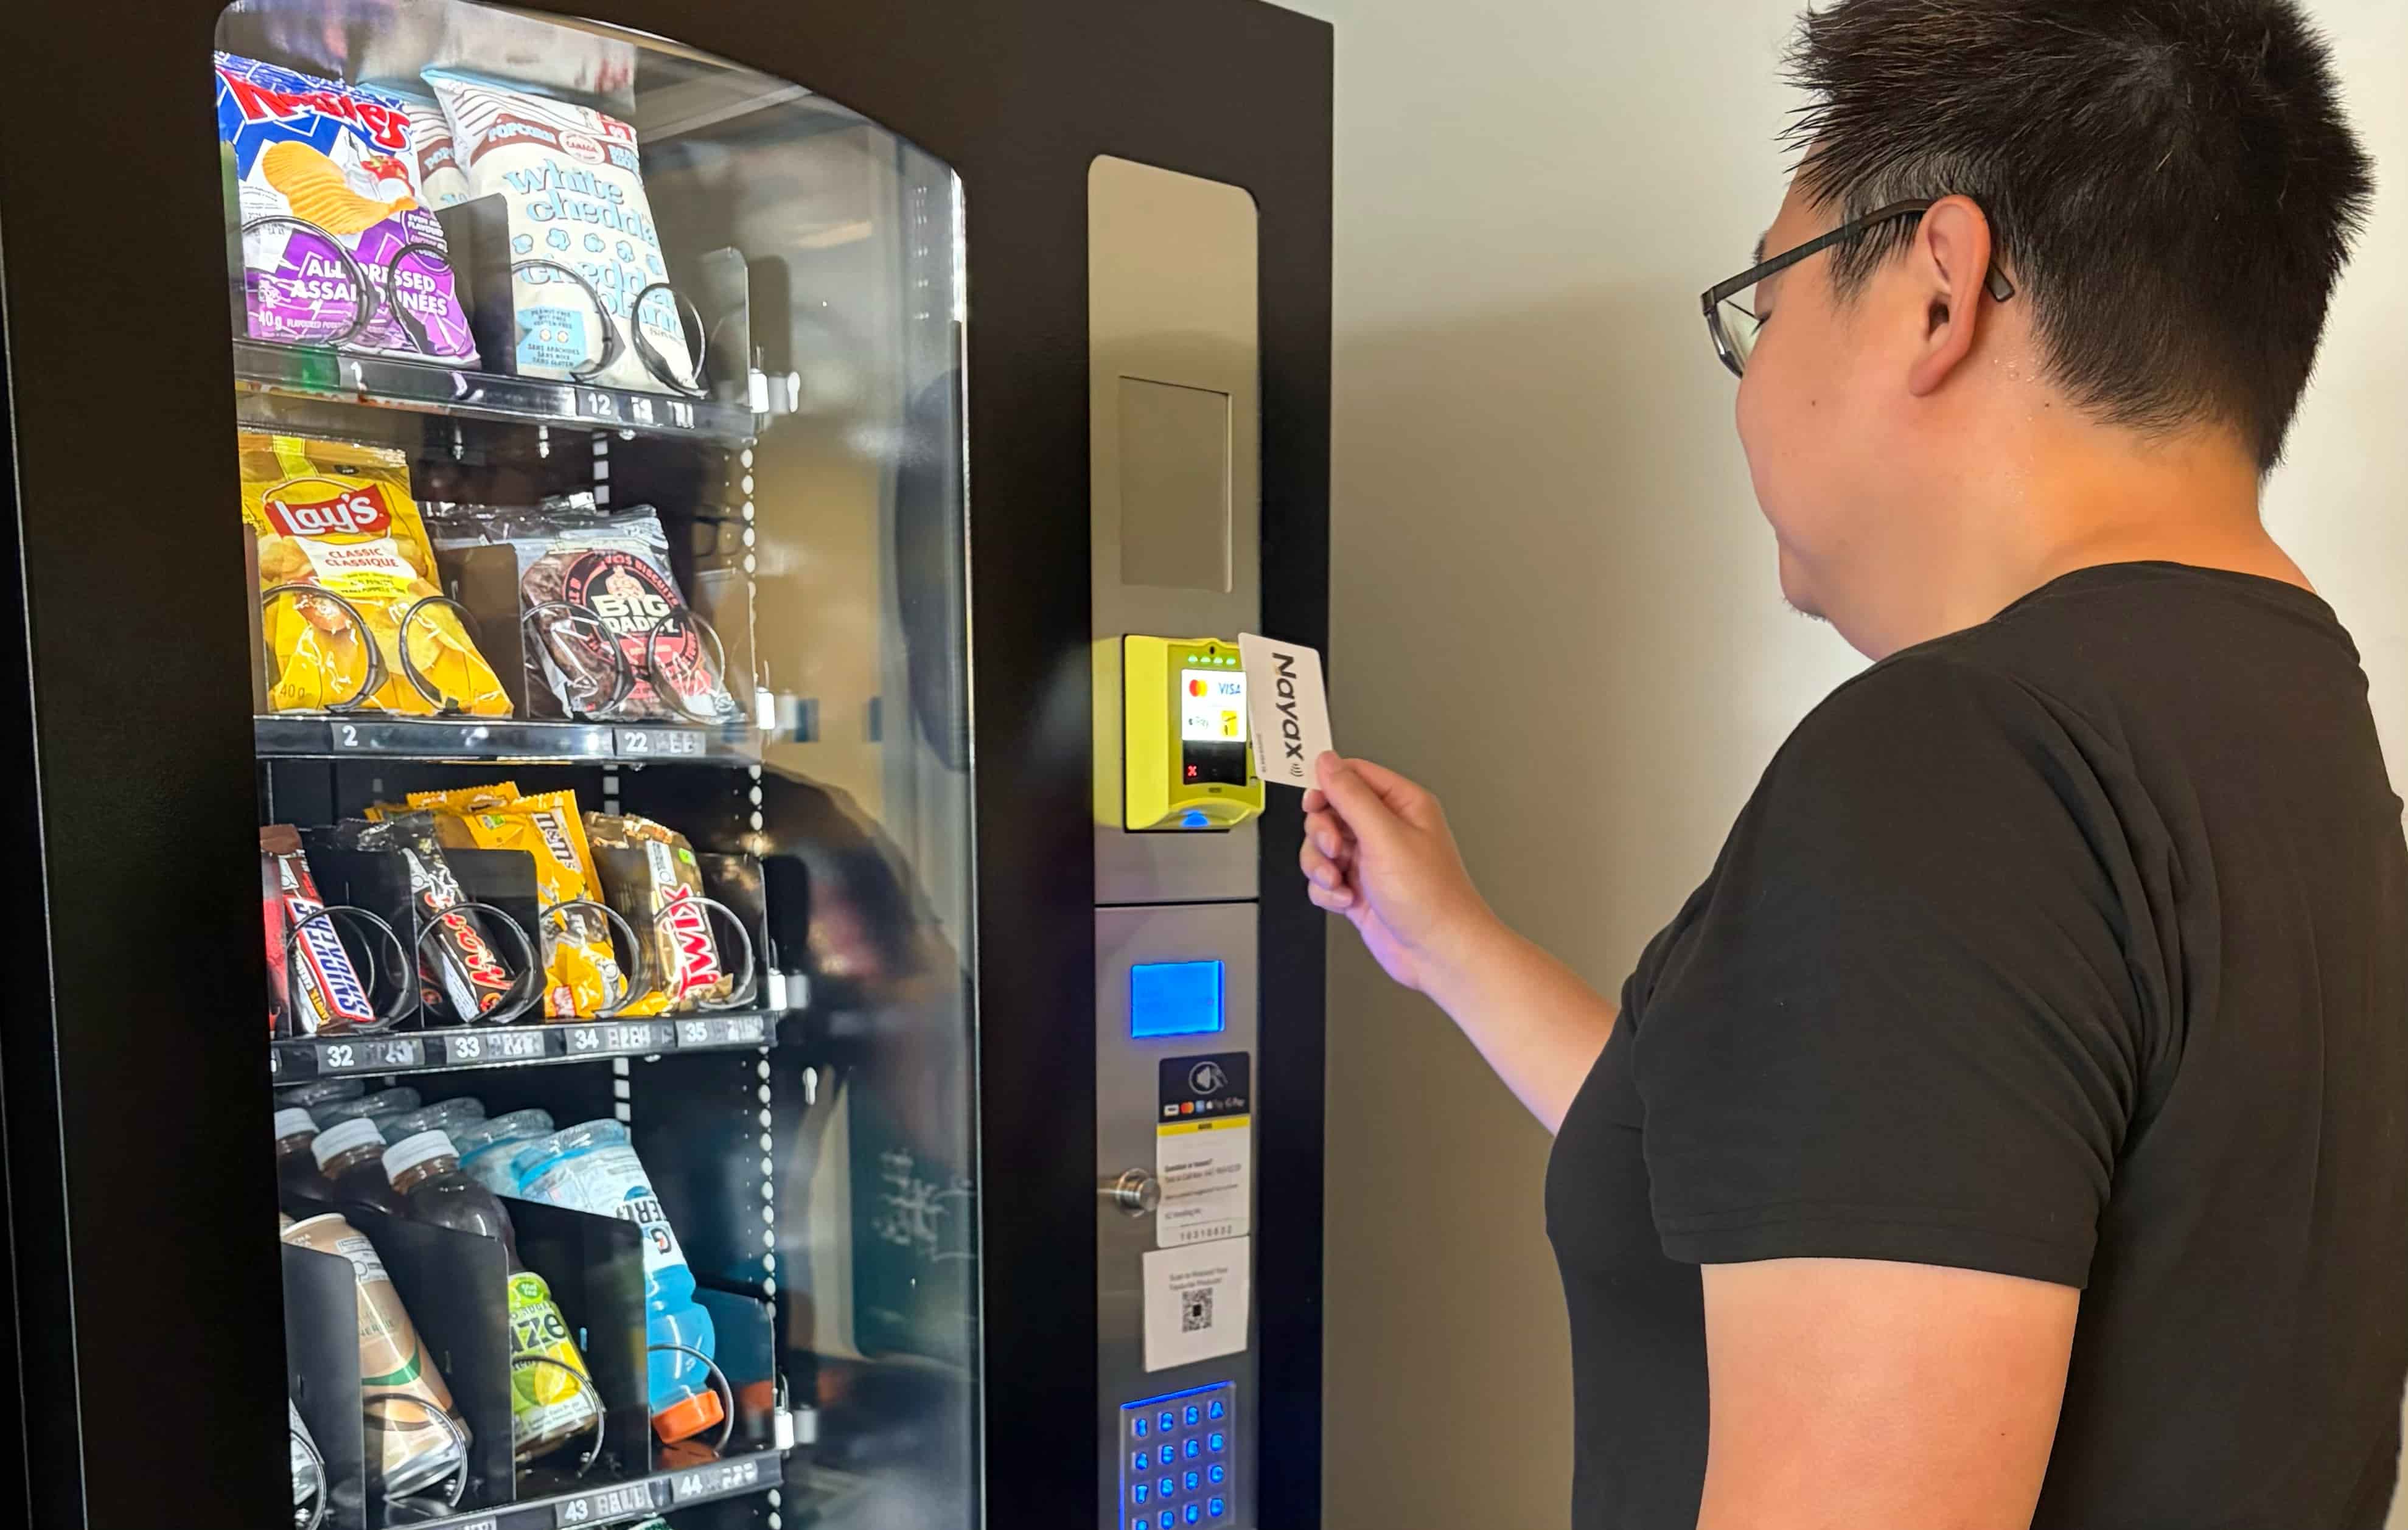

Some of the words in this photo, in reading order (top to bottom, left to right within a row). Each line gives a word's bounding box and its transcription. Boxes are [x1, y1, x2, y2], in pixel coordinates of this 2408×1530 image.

[501, 158, 624, 205] white
[306, 259, 346, 279] ALL
[588, 392, 610, 415] 12
[274, 493, 378, 535] Lay's
[324, 558, 399, 568] CLASSIQUE
[328, 548, 384, 558] CLASSIC
[590, 593, 671, 617] BIG
[281, 684, 295, 698] 40
[1218, 681, 1241, 695] VISA
[1271, 652, 1305, 761] Nayax
[341, 725, 358, 746] 2
[624, 732, 648, 753] 22
[661, 883, 721, 1001] TWIX
[574, 1028, 599, 1049] 34
[685, 1022, 707, 1041] 35
[327, 1045, 355, 1067] 32
[455, 1037, 481, 1059] 33
[650, 1228, 672, 1255] G
[680, 1474, 703, 1495] 44
[564, 1500, 588, 1521] 43
